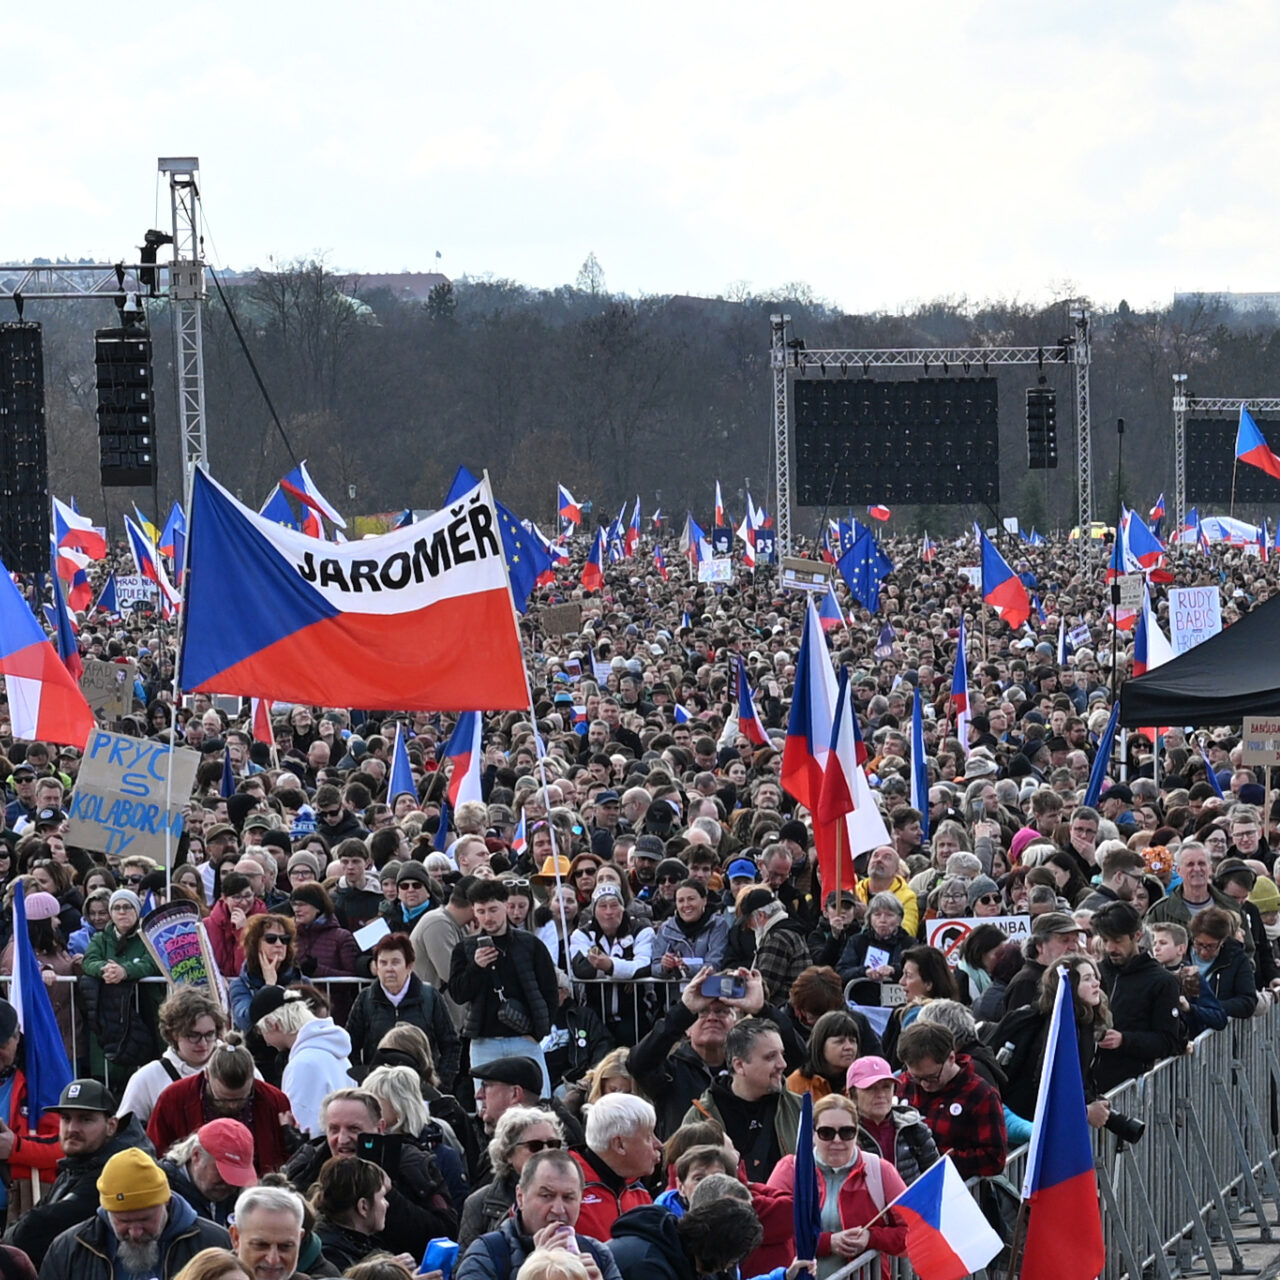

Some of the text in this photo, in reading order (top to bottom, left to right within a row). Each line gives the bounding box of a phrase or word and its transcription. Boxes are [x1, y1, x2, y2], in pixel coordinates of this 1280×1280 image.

[297, 491, 500, 592] JAROMĚŘ
[756, 539, 773, 553] P3
[120, 773, 150, 797] S
[102, 826, 136, 855] TY
